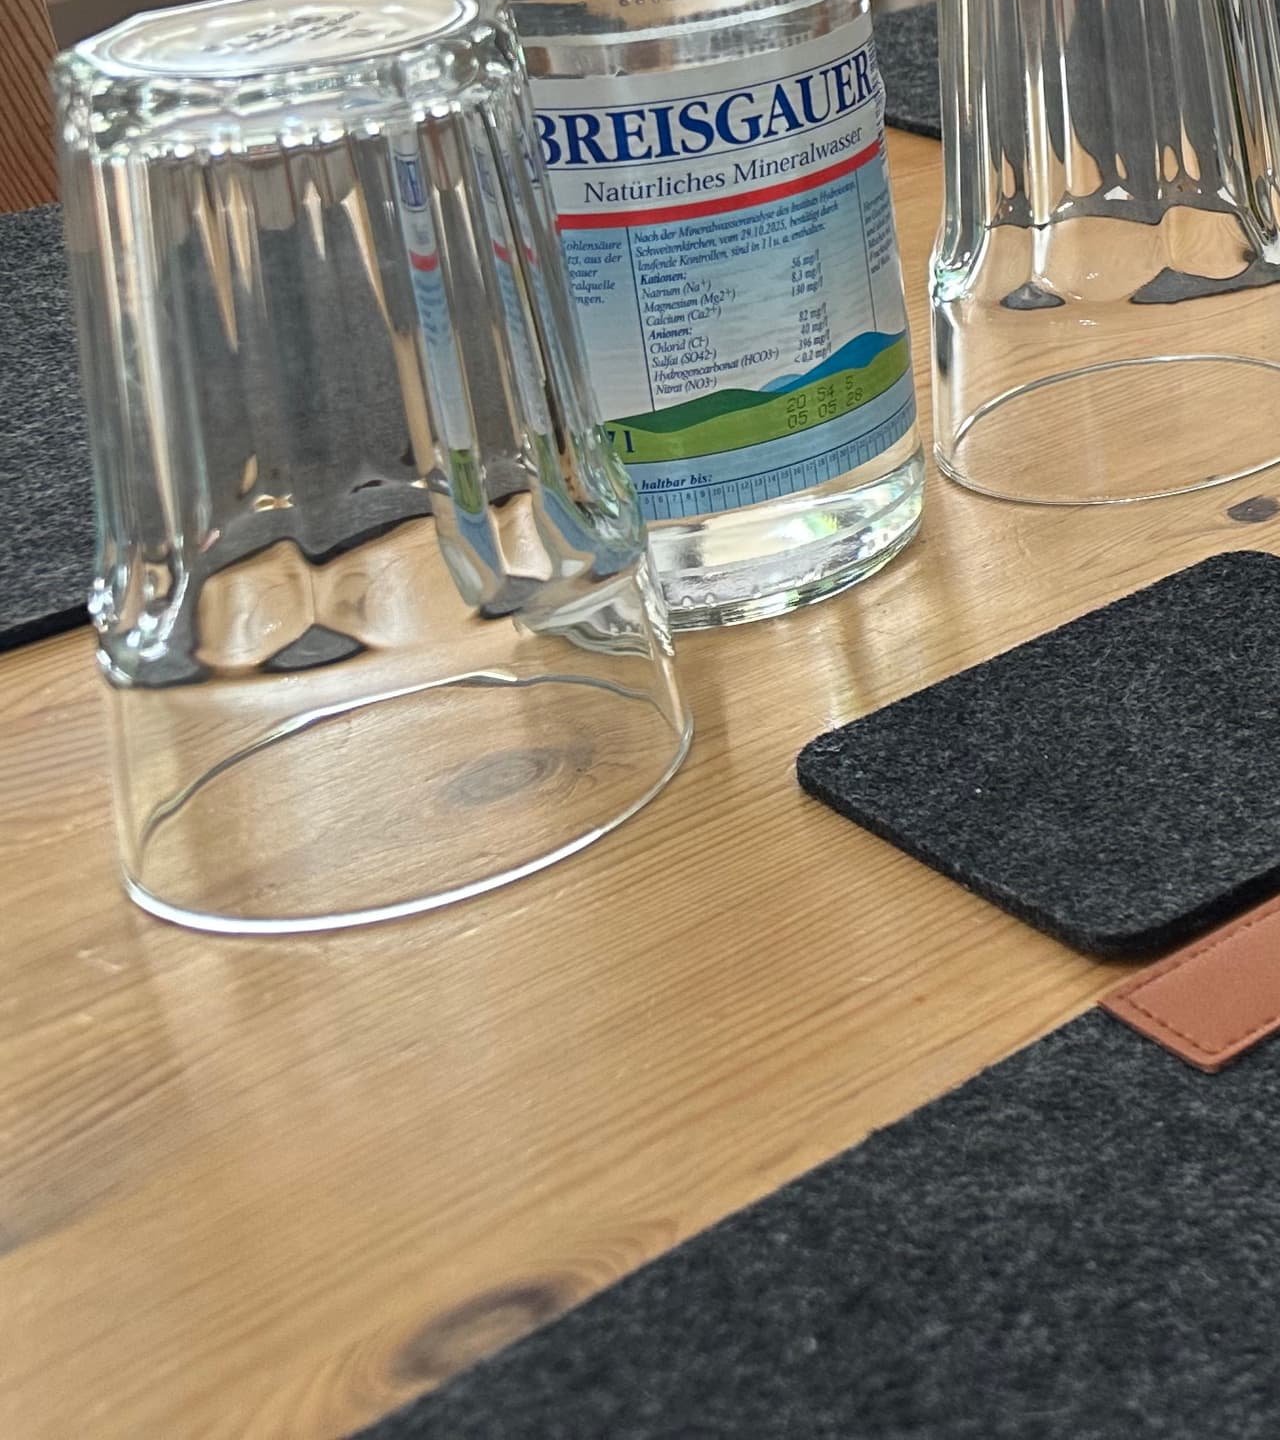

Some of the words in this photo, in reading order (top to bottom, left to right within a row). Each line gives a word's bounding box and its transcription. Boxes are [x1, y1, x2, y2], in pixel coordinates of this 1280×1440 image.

[535, 48, 875, 166] BREISGAUER
[583, 169, 726, 204] Natürliches
[733, 126, 864, 185] Mineralwasser
[566, 240, 622, 252] ohlensäure
[584, 256, 602, 265] aus
[604, 253, 623, 264] der
[571, 280, 616, 293] ralquelle
[640, 272, 687, 286] Kationen:
[643, 296, 698, 315] Magnesium
[645, 313, 686, 328] Calcium
[648, 326, 693, 342] Anionen:
[650, 339, 686, 355] Chlorid
[652, 354, 679, 369] Sulfat
[655, 382, 683, 396] Nitrat
[786, 393, 807, 414] 20
[787, 409, 809, 429] 05
[818, 398, 837, 419] 05
[641, 477, 687, 490] haltbar
[690, 472, 713, 485] bis:
